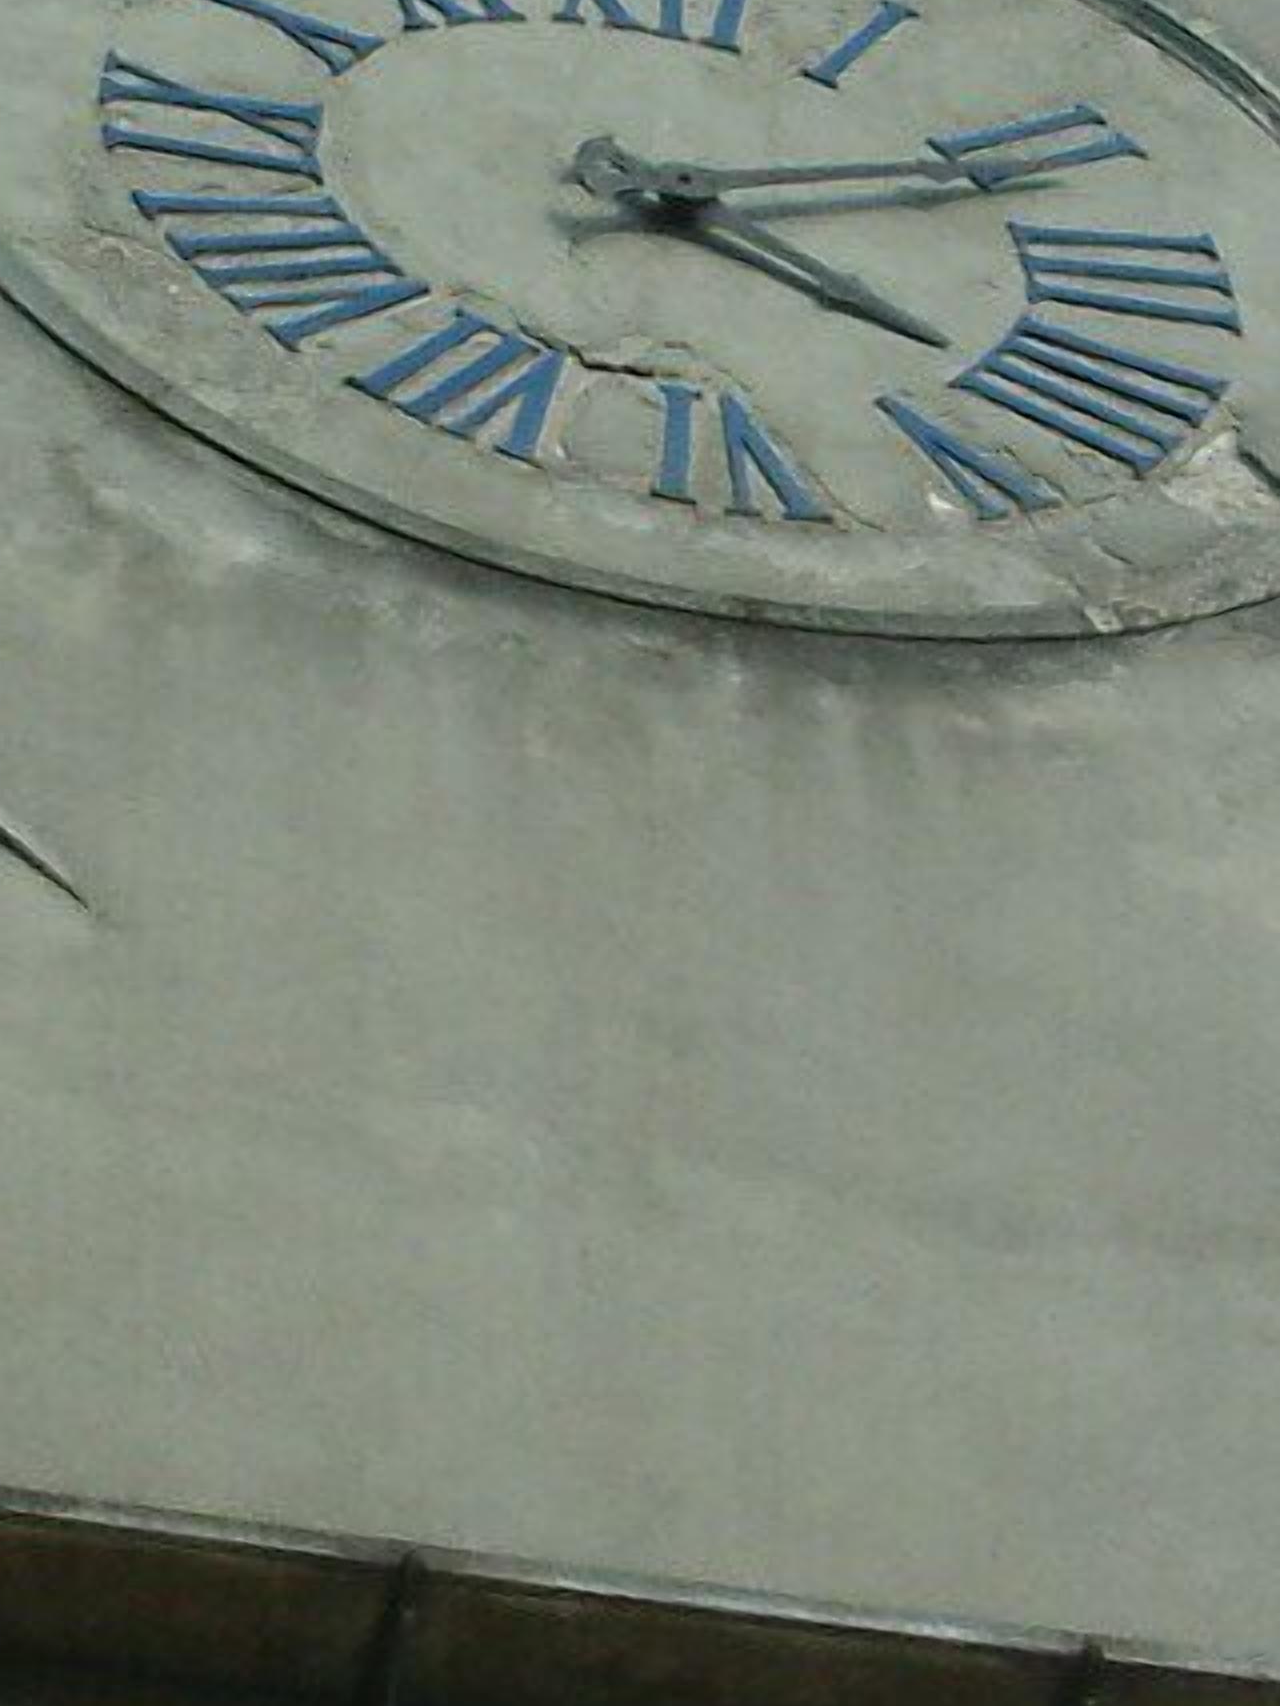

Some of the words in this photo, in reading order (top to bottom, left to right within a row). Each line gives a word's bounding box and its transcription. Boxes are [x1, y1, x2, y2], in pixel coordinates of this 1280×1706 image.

[800, 0, 921, 89] I
[99, 48, 324, 185] IX
[924, 103, 1149, 192] II
[132, 191, 430, 352] VIII
[1007, 221, 1244, 335] III
[343, 306, 567, 466] VII
[649, 381, 834, 522] VI
[873, 395, 1062, 519] V
